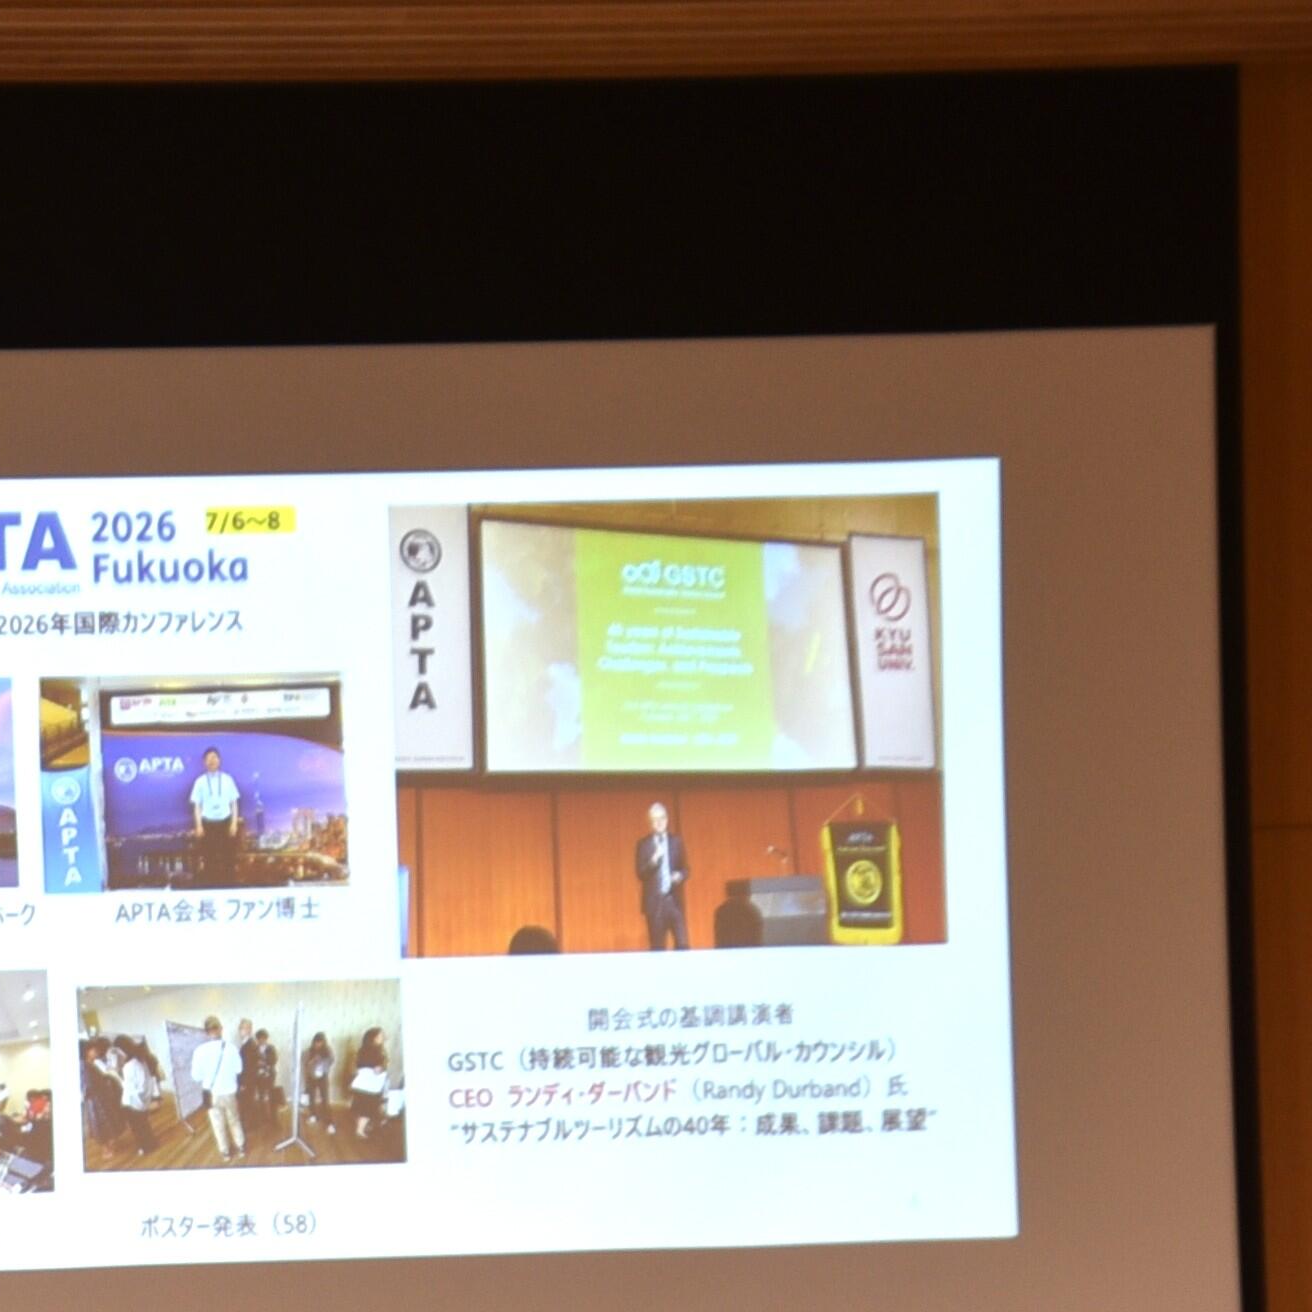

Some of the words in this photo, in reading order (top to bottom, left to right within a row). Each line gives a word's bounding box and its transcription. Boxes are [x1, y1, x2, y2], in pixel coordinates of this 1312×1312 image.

[91, 510, 177, 544] 2026
[93, 549, 249, 584] Fukuoka
[1, 581, 80, 597] Association
[408, 580, 437, 710] APTA
[138, 756, 185, 773] APTA
[114, 899, 217, 923] APTA会長
[226, 896, 320, 922] ファン博士
[448, 1088, 494, 1109] CEO
